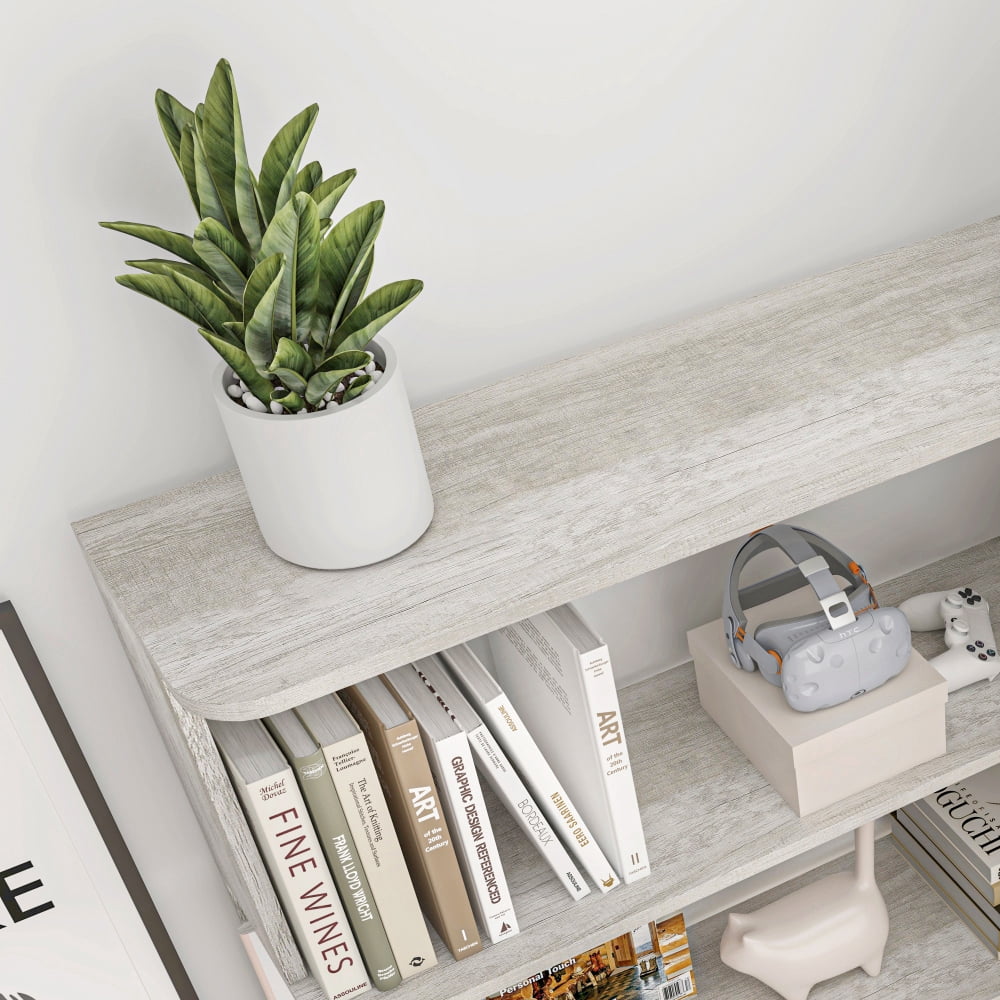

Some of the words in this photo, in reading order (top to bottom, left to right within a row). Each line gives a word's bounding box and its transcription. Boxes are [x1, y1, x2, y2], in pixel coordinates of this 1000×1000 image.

[596, 710, 622, 746] ART
[259, 779, 286, 796] Michel
[262, 787, 287, 802] Dovaz
[356, 777, 369, 792] The
[361, 792, 373, 804] Art
[408, 785, 440, 822] ART
[550, 791, 578, 829] SAARINEN
[367, 812, 386, 841] Knitting
[423, 830, 431, 838] of
[431, 826, 442, 835] the
[452, 756, 474, 804] GRAPHIC
[464, 804, 484, 841] DESIGN
[475, 839, 502, 905] REFERENCED
[517, 798, 554, 847] BORDEAUX
[425, 839, 449, 853] Century
[428, 834, 442, 844] 20th
[573, 824, 590, 848] EERO
[269, 807, 318, 878] FINE
[300, 881, 354, 975] WINES
[332, 834, 353, 864] FRANK
[343, 862, 361, 890] LLOYD
[352, 888, 374, 922] WRIGHT
[333, 981, 368, 1000] ASSOULINE
[500, 972, 544, 998] Personal
[549, 958, 576, 975] Touch
